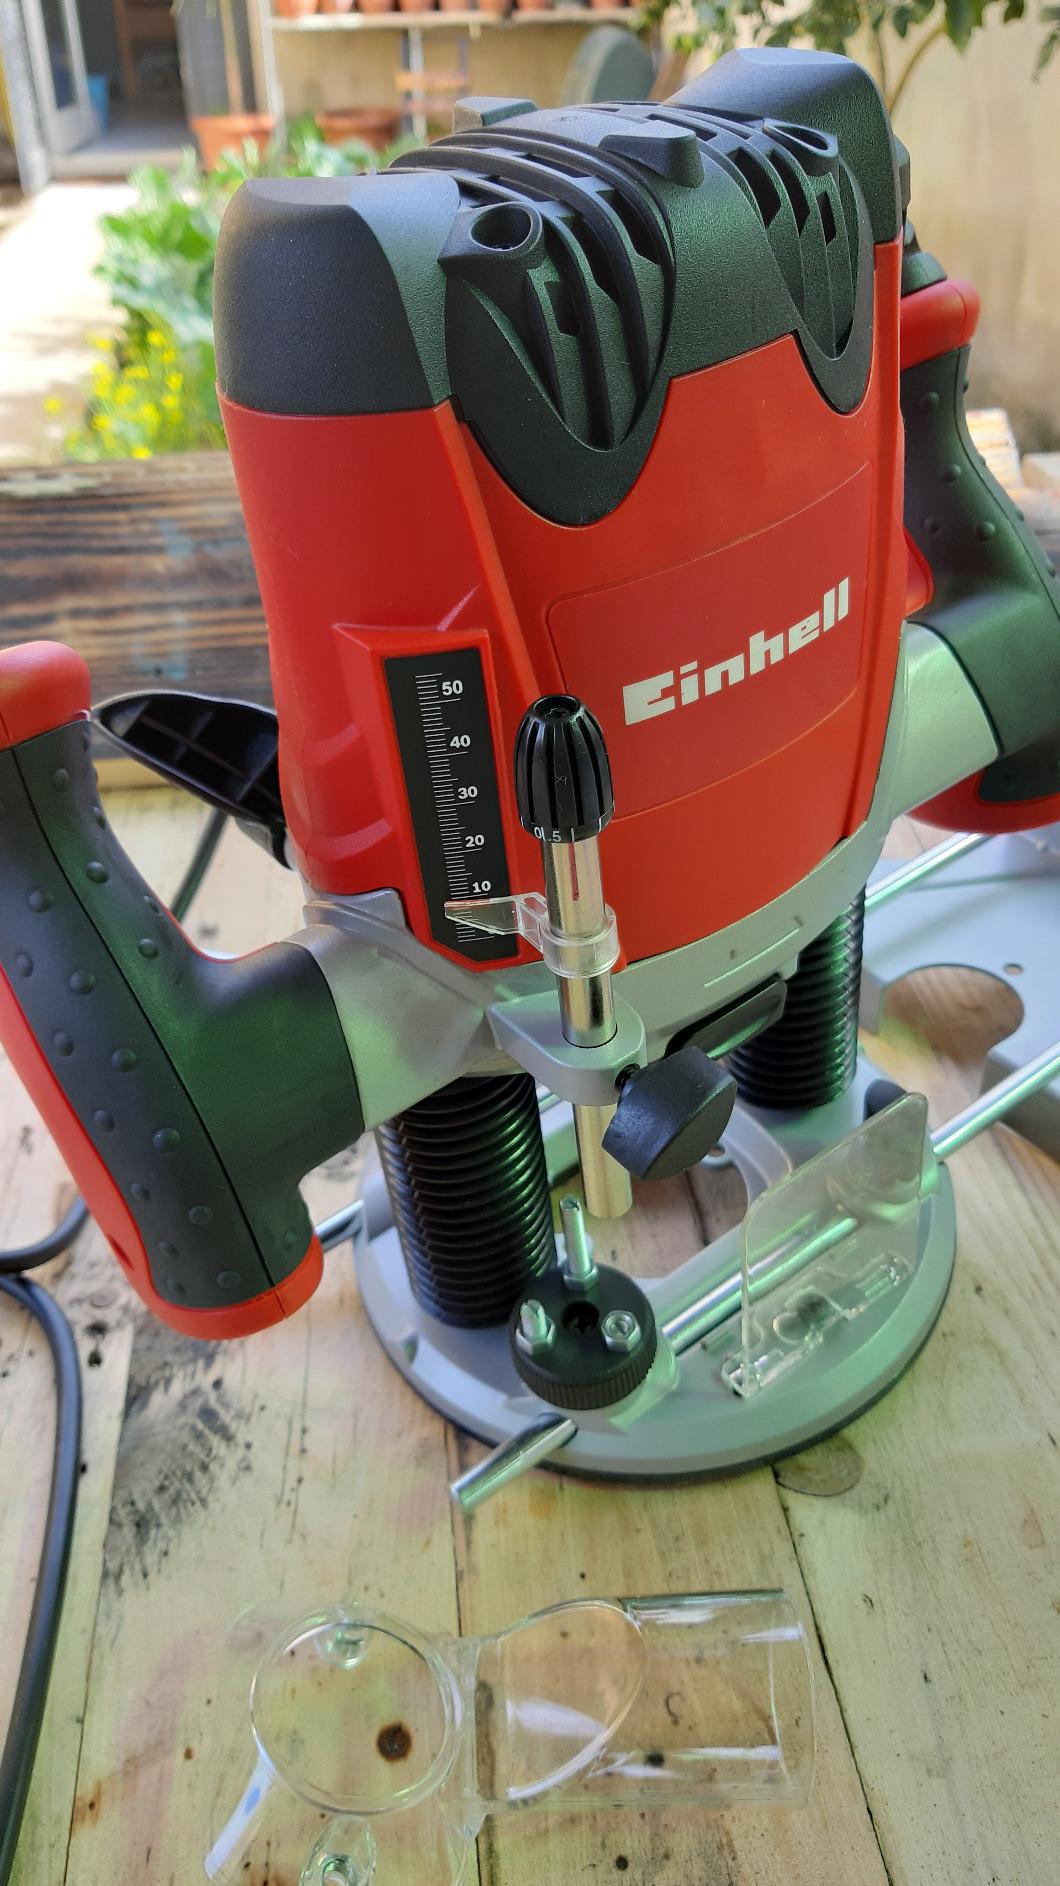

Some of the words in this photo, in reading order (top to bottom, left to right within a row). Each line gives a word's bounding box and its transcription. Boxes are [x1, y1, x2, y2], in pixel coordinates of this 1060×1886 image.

[622, 576, 849, 726] Einhell
[441, 680, 464, 696] 50
[449, 735, 471, 748] 40
[457, 786, 478, 800] 30
[464, 834, 486, 848] 20
[472, 880, 492, 894] 10
